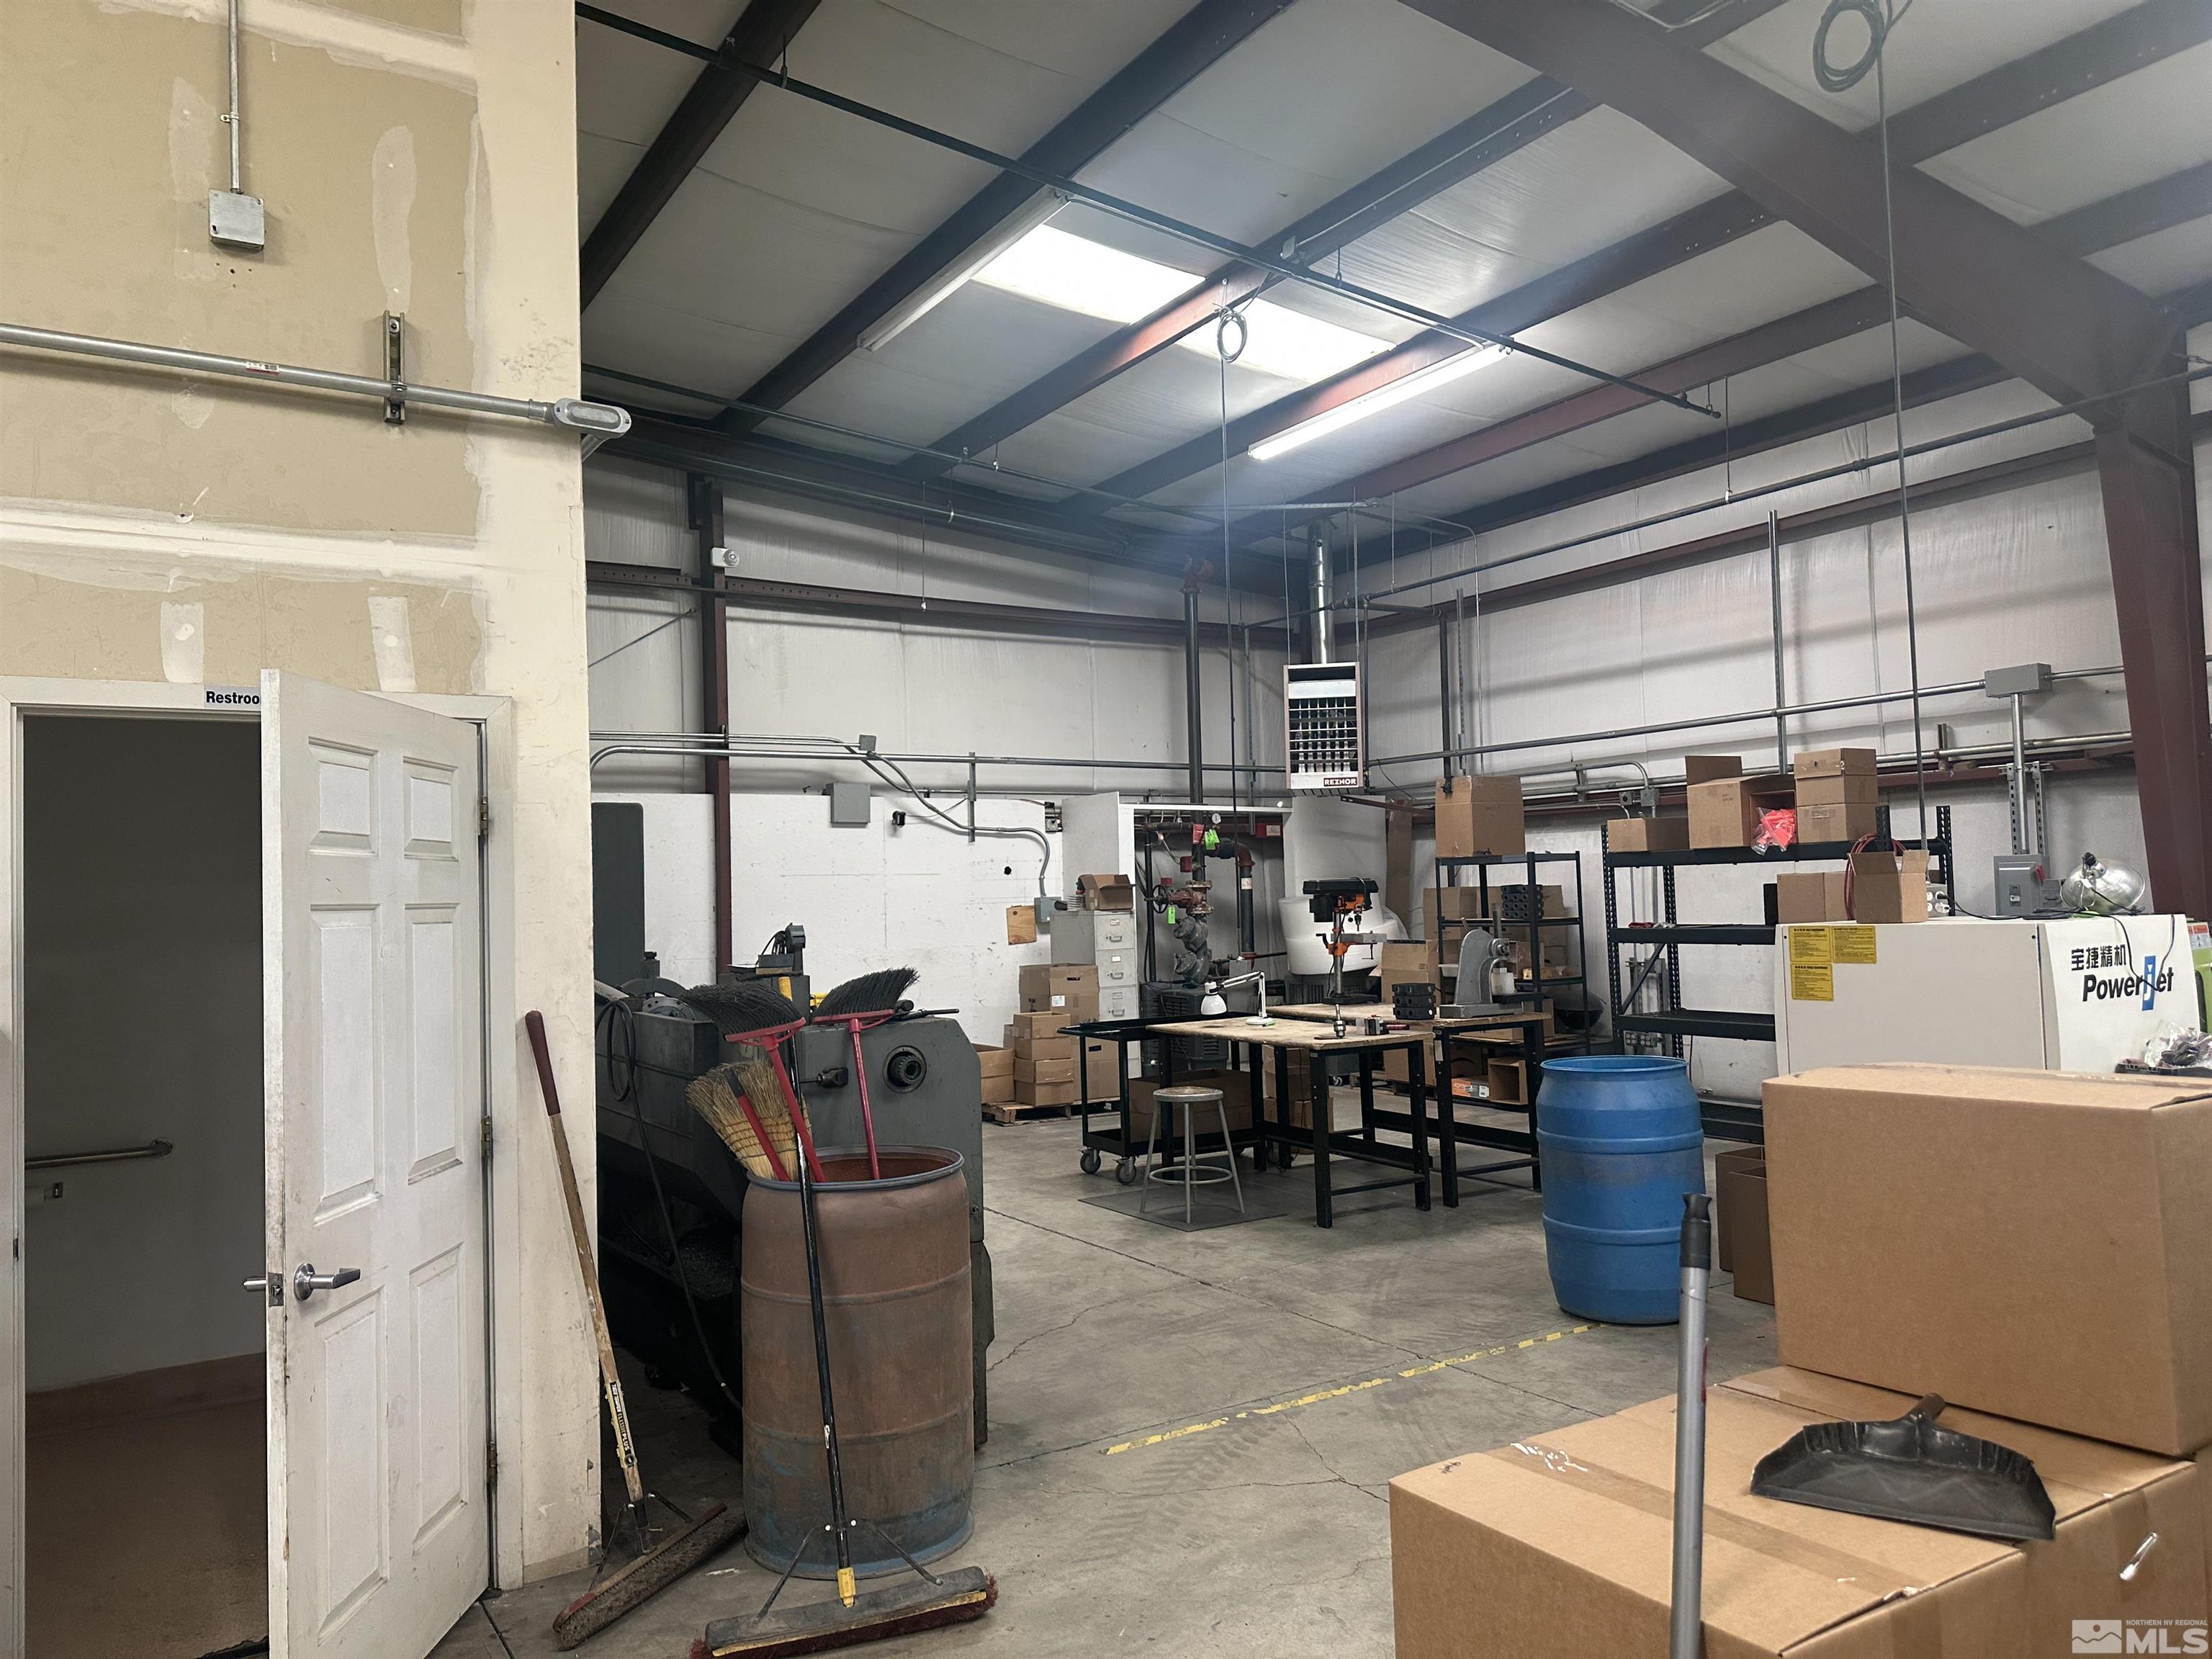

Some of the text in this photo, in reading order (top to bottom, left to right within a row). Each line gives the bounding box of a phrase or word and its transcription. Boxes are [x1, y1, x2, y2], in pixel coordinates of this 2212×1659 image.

[206, 691, 260, 705] Restroo
[2071, 945, 2126, 971] 宝捷精机
